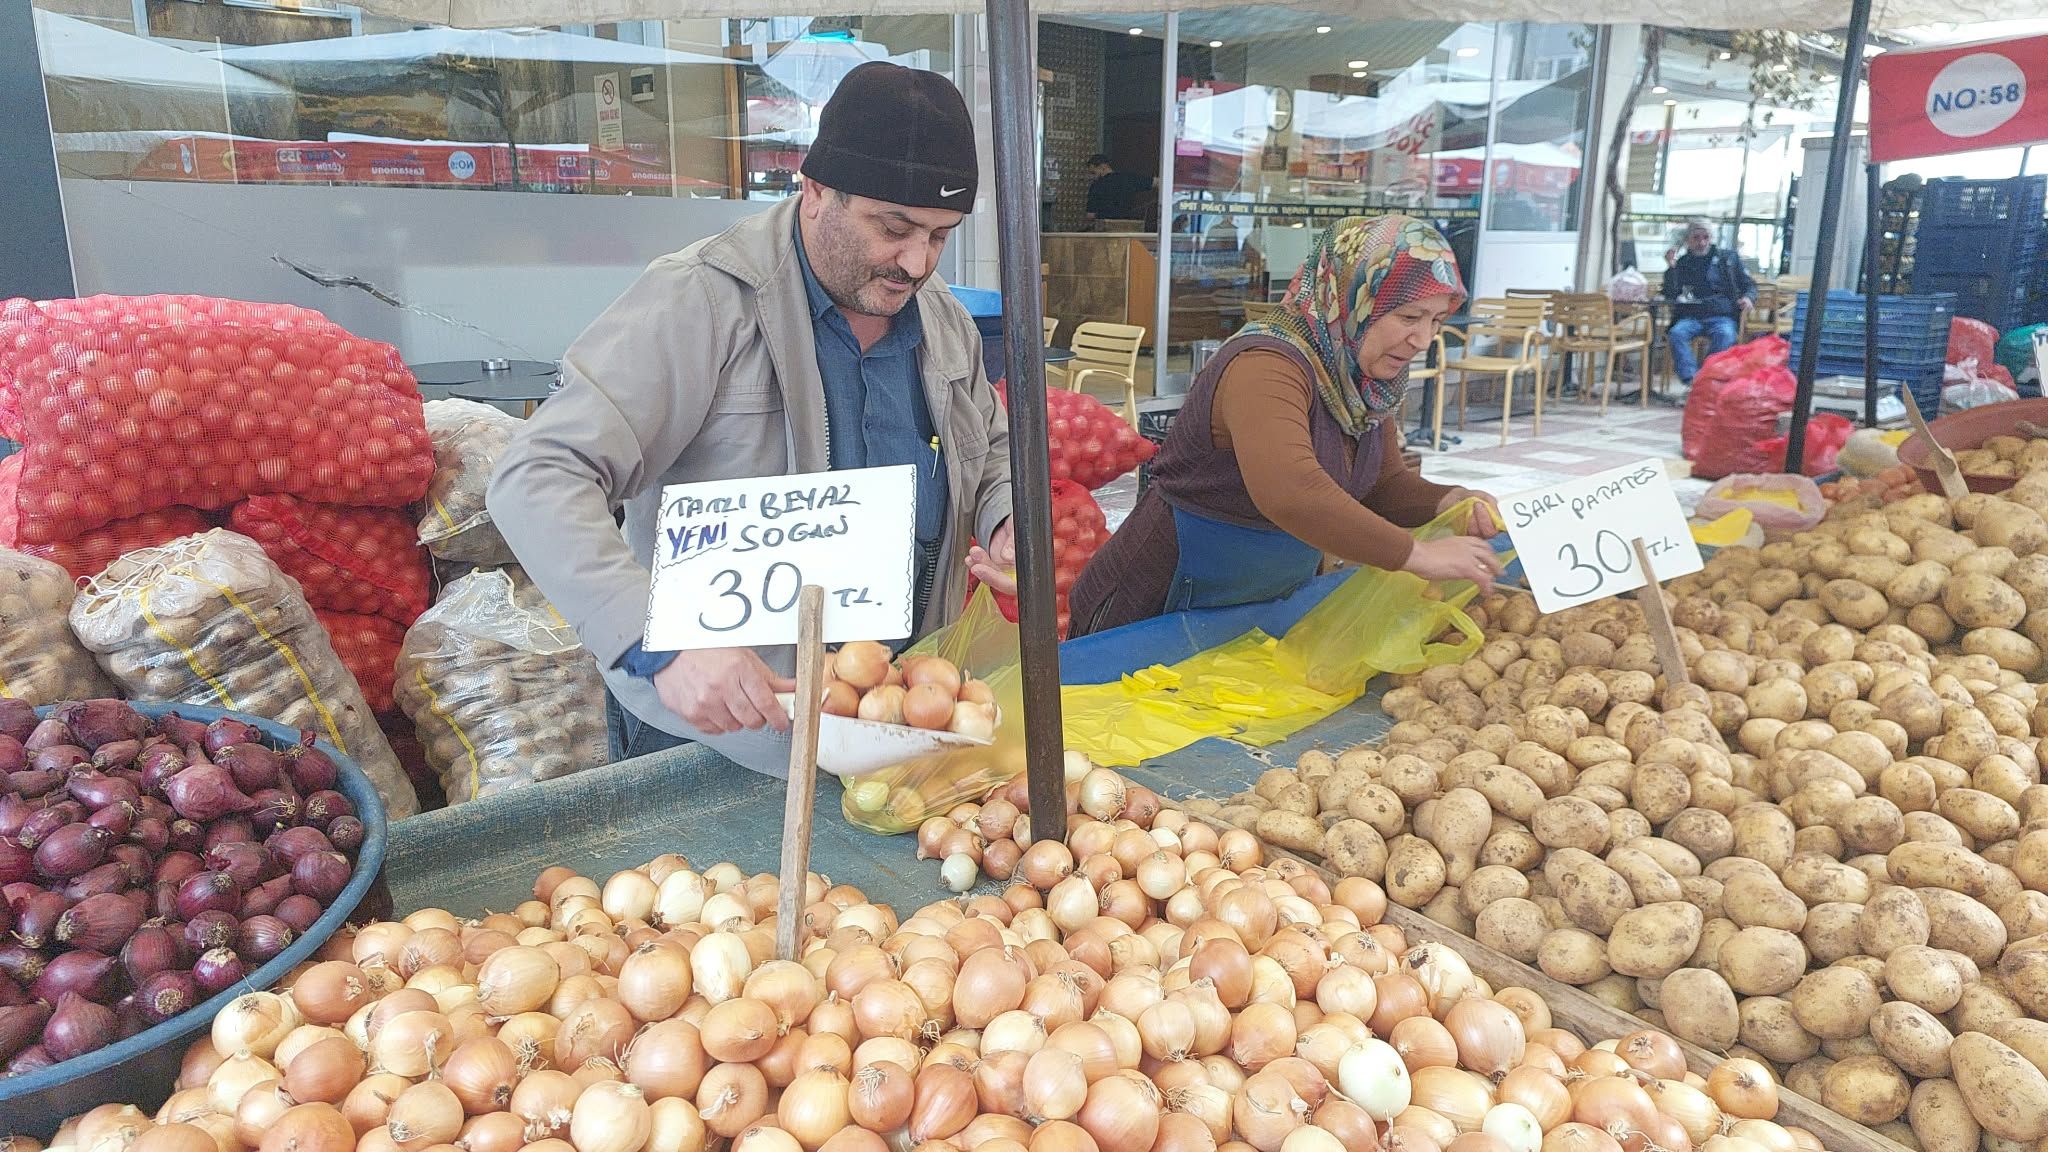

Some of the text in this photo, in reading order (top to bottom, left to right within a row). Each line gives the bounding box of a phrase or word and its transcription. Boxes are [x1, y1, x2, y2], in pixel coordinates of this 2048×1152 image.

[1933, 83, 2020, 113] NO:58
[666, 485, 861, 519] TATLI BEYAZ
[1513, 467, 1658, 528] SARI PATATES
[666, 516, 727, 560] YENİ
[1553, 530, 1632, 597] 30
[699, 562, 802, 632] 30
